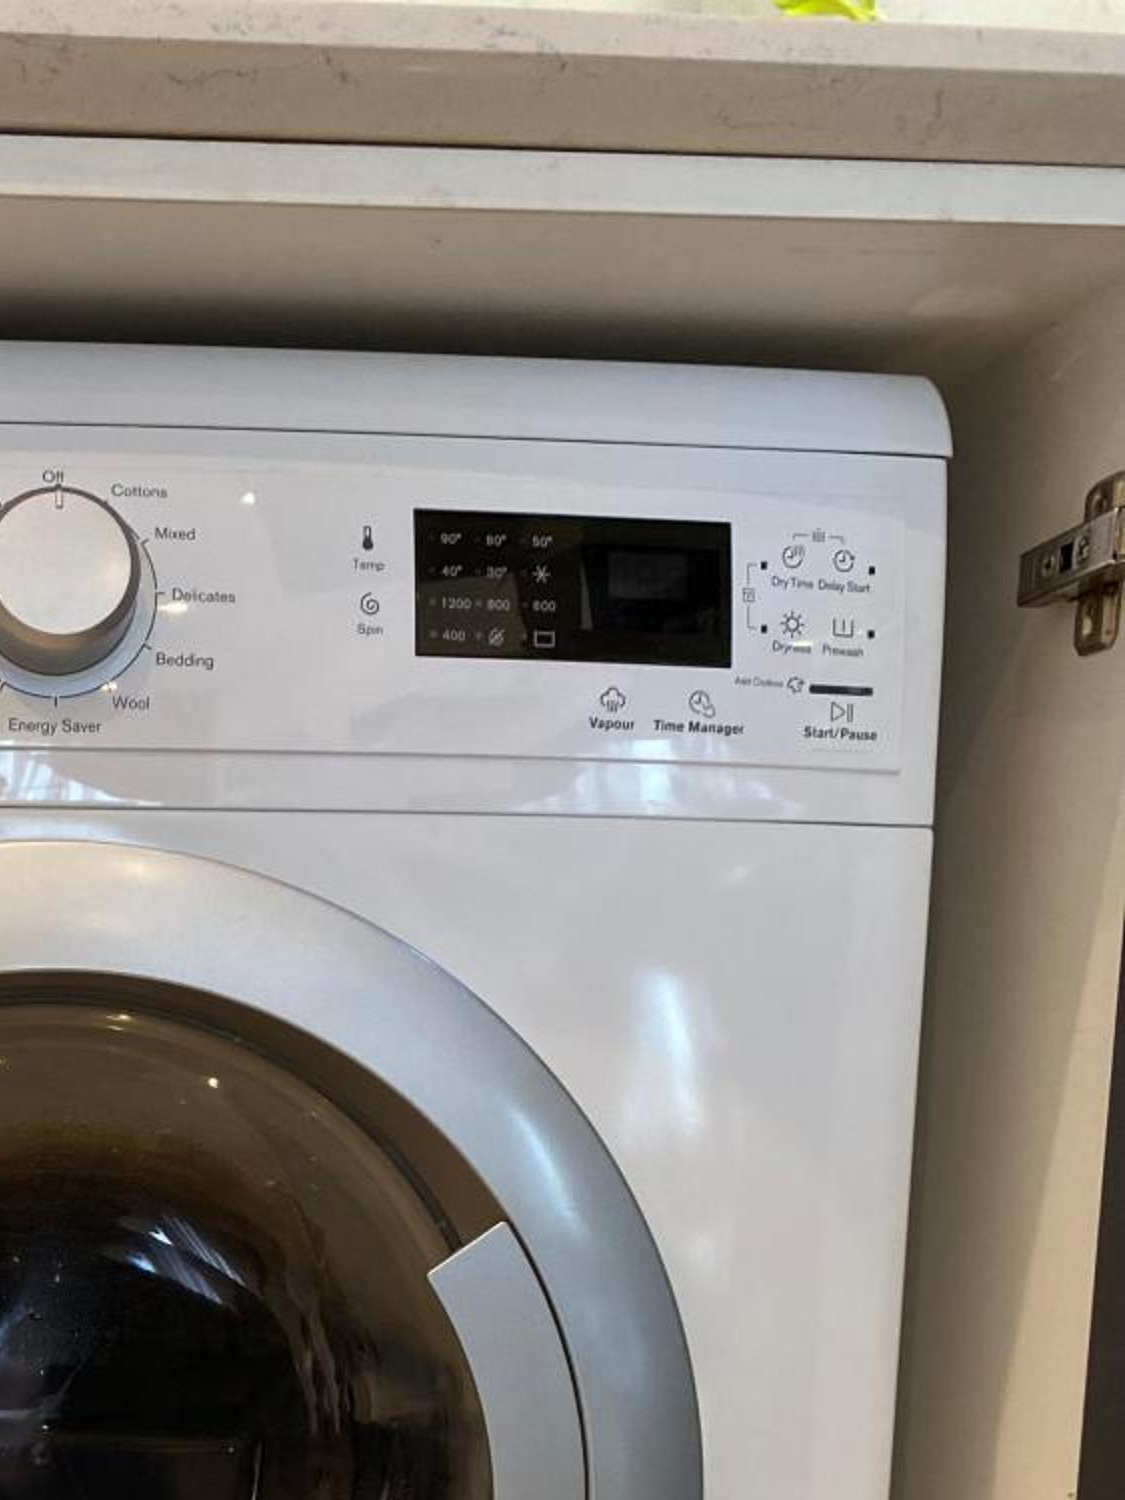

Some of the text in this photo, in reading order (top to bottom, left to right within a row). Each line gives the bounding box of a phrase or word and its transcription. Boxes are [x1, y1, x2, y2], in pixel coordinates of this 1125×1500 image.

[42, 469, 65, 483] Off
[111, 483, 168, 498] Cottons
[155, 527, 196, 541] Mixed
[352, 559, 386, 572] Temp
[772, 575, 814, 590] Dry Time
[172, 588, 236, 603] Delicates
[442, 598, 472, 609] 1200
[356, 624, 384, 636] Spin
[442, 629, 466, 642] 400
[155, 652, 214, 670] Bedding
[112, 696, 150, 710] Wool
[9, 718, 101, 735] Energy Saver
[588, 717, 635, 733] Vapour
[653, 719, 745, 736] Time Manager
[804, 725, 878, 741] Start/Pause
